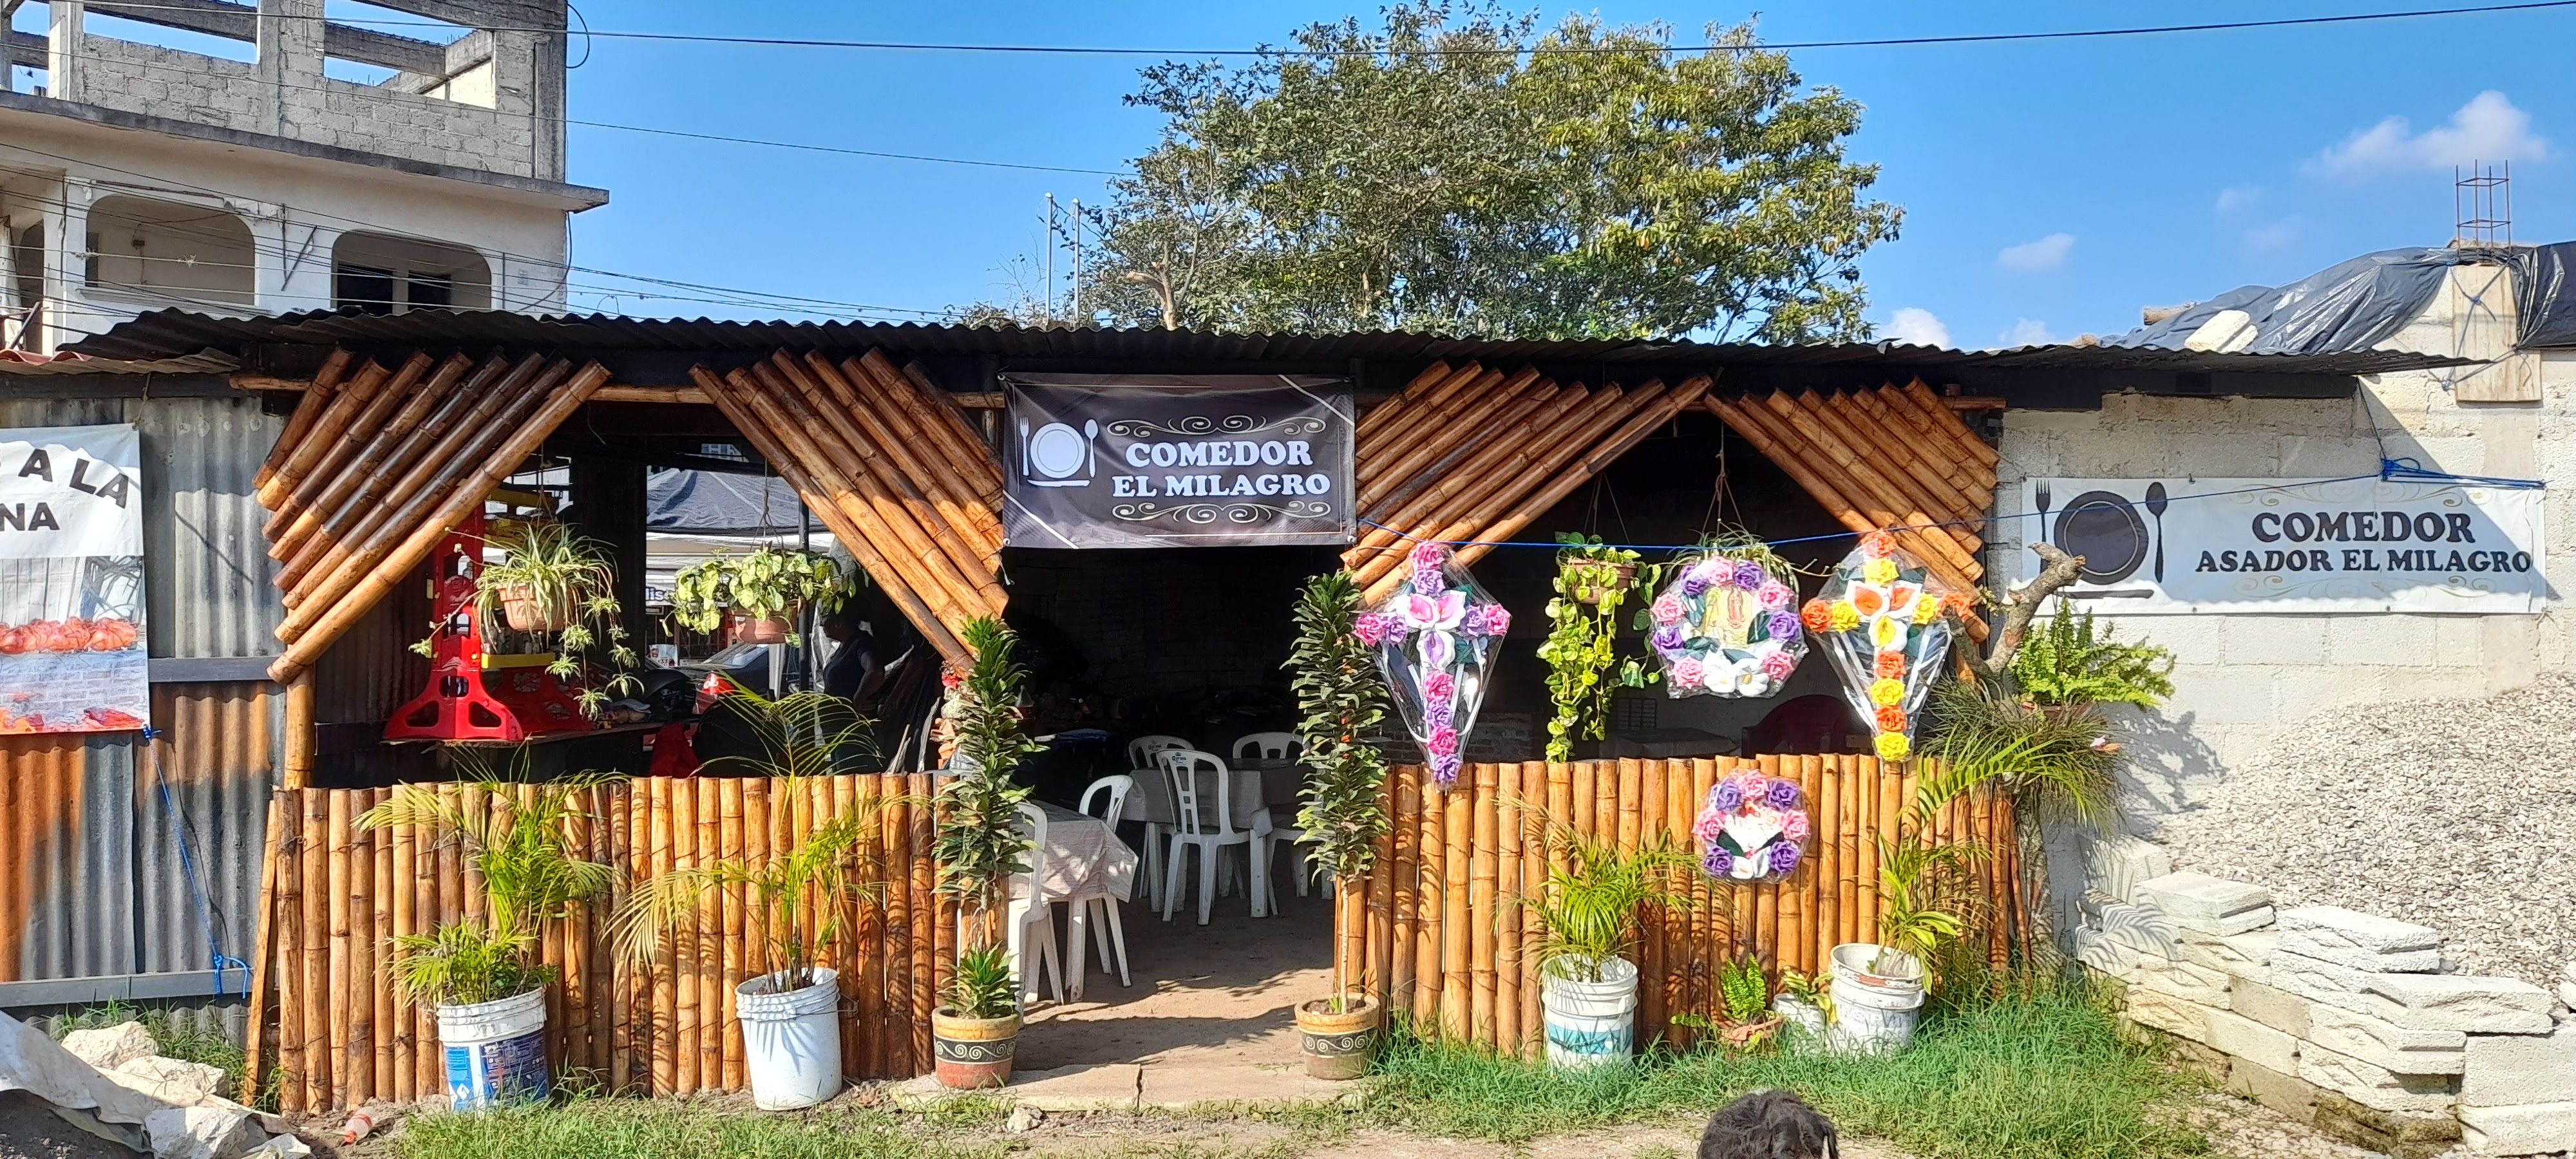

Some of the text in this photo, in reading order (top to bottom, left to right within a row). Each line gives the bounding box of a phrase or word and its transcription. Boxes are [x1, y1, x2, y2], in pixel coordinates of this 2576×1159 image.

[1125, 440, 1313, 467] COMEDOR
[18, 448, 129, 509] A LA
[1112, 473, 1331, 497] EL MILAGRO
[2251, 511, 2476, 543] COMEDOR
[2195, 549, 2532, 573] ASADOR EL MILAGRO
